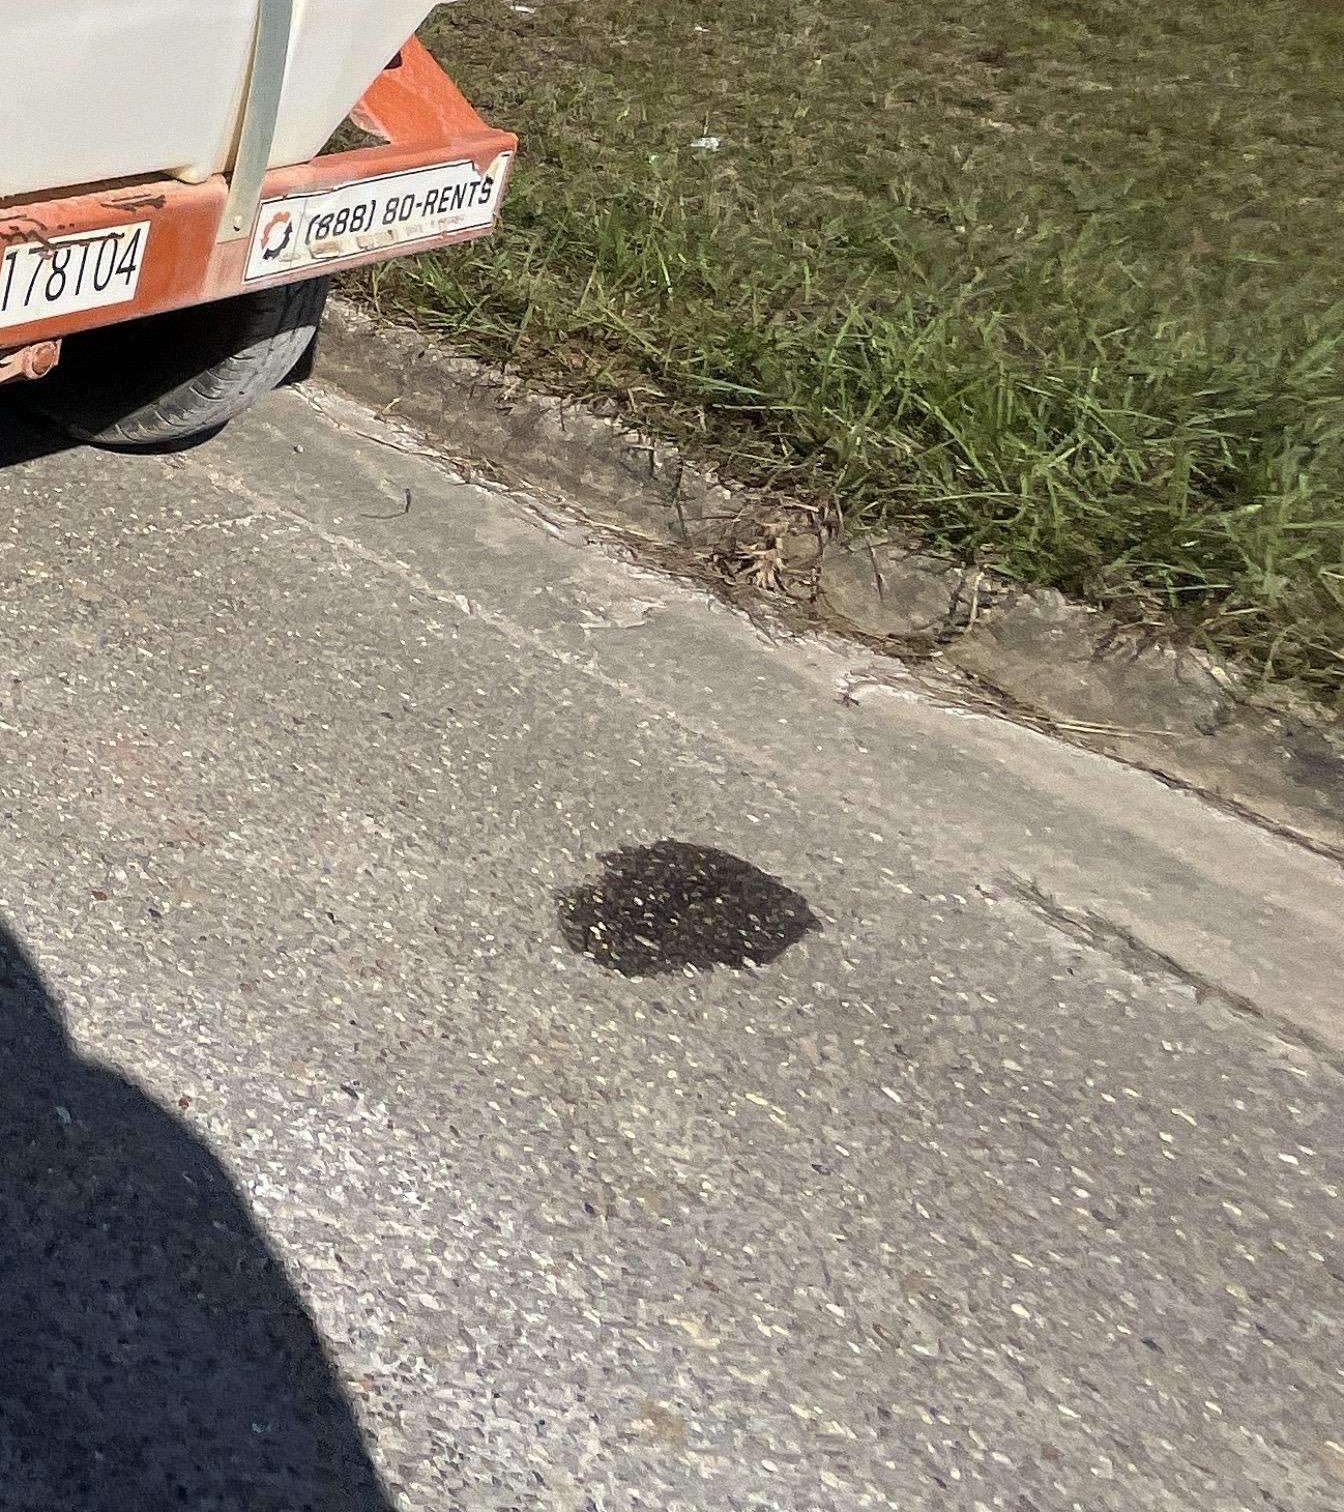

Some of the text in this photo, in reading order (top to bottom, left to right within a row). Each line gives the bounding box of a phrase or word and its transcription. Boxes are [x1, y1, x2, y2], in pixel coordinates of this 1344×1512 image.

[305, 176, 494, 246] (888) 80-RENTS
[0, 228, 142, 312] 178104
